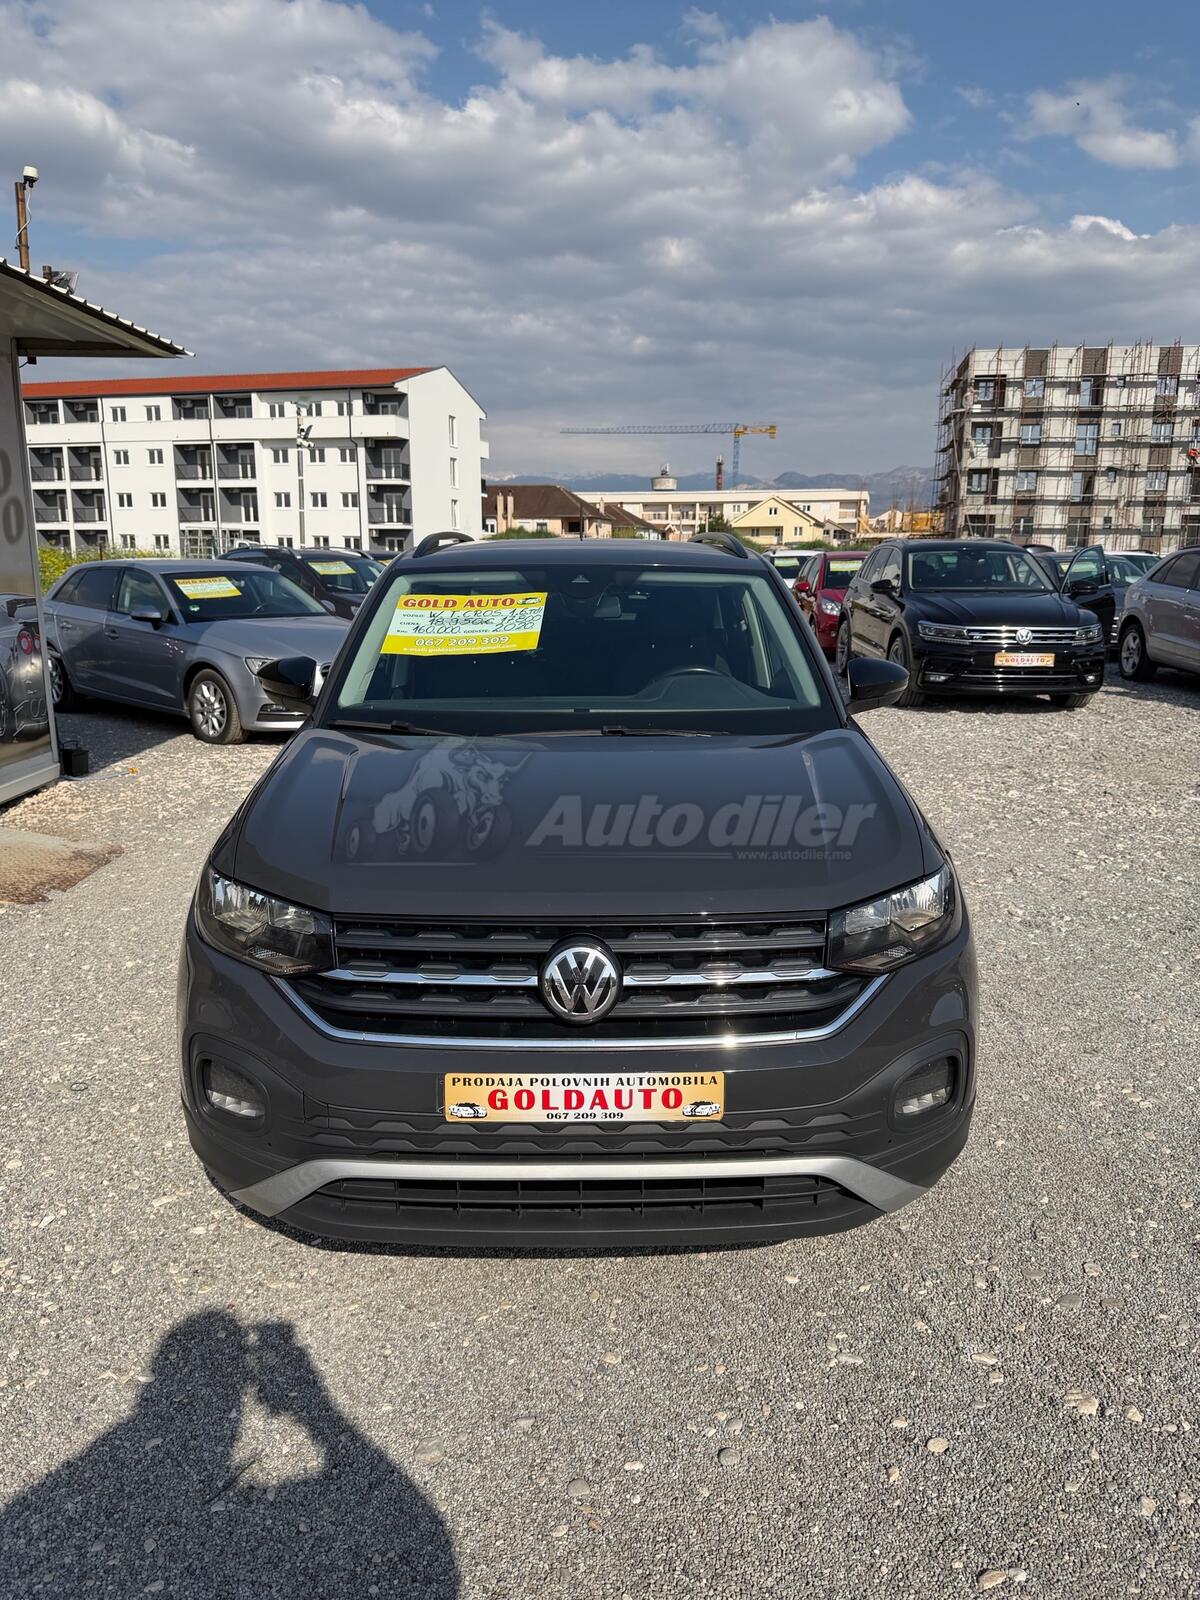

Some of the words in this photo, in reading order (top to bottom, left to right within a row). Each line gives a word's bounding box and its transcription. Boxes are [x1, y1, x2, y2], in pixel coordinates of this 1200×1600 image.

[403, 598, 457, 608] GOLD
[463, 597, 516, 608] AUTO
[415, 638, 445, 647] 067
[448, 637, 477, 646] 209
[481, 636, 510, 645] 309
[452, 1077, 523, 1087] PRODAJA
[530, 1076, 611, 1087] POLOVNIH
[616, 1075, 718, 1086] AUTOMOBILA
[487, 1087, 683, 1111] GOLDAUTO
[546, 1112, 569, 1120] 067
[573, 1112, 597, 1120] 209
[600, 1111, 624, 1120] 309
